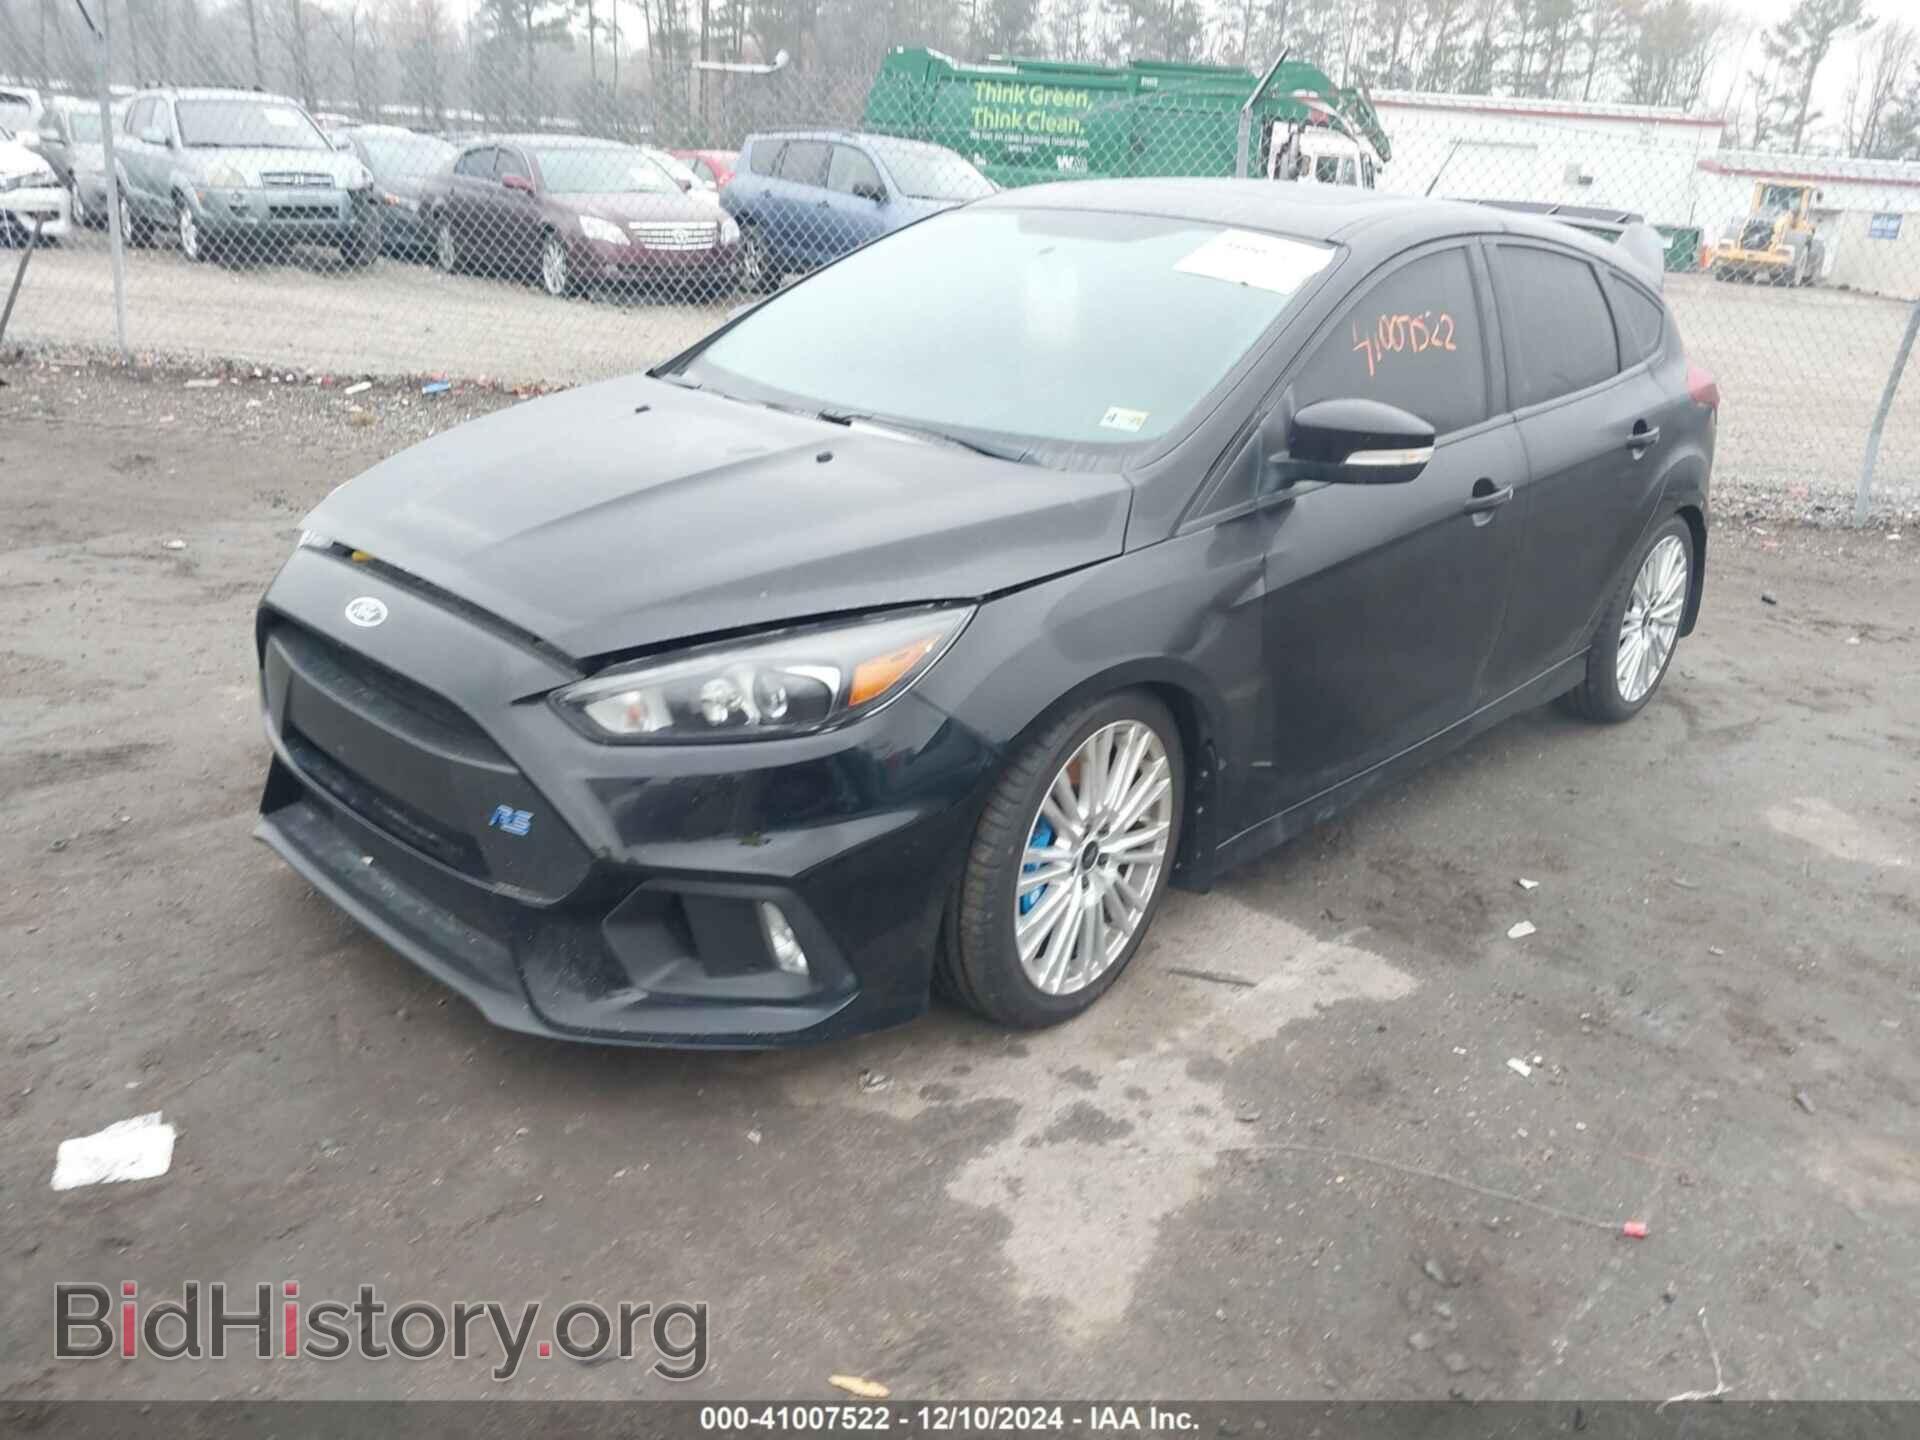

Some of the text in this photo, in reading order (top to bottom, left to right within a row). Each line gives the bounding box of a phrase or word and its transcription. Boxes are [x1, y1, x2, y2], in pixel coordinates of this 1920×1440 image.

[975, 81, 1024, 104] Think
[971, 106, 1021, 129] Think
[488, 804, 535, 836] RS
